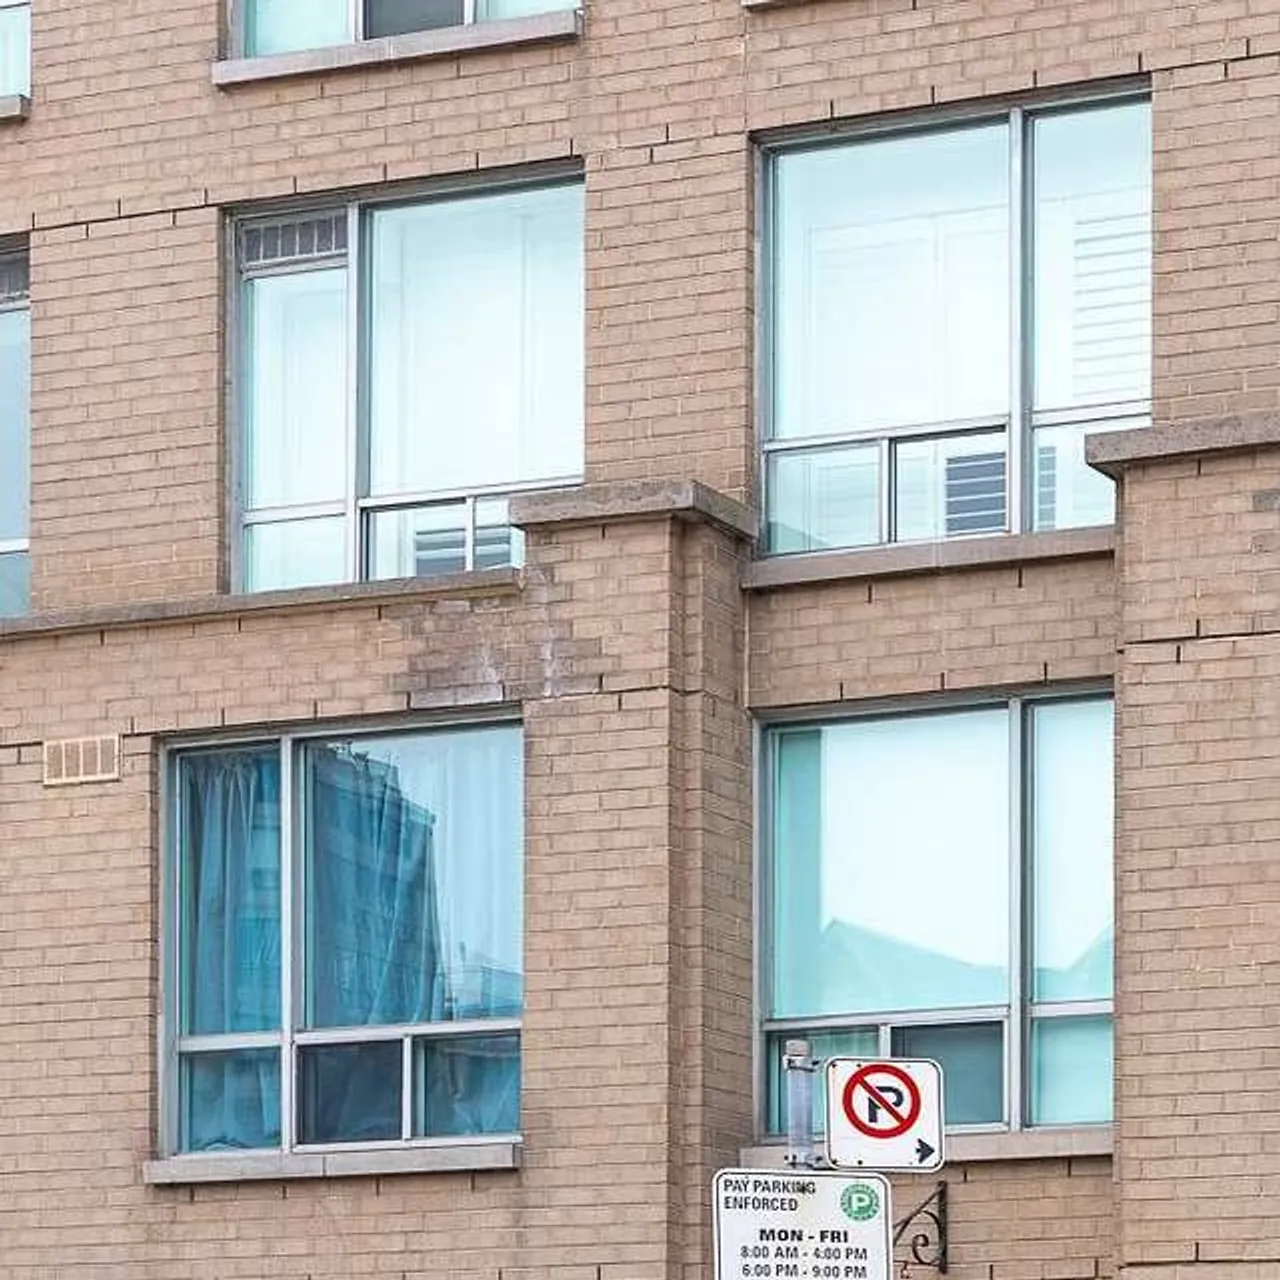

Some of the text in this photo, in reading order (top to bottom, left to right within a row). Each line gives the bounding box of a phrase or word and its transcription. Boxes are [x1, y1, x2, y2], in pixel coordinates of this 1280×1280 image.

[723, 1179, 816, 1194] PAY PARKING
[723, 1197, 798, 1211] ENFORCED
[759, 1229, 803, 1241] MON
[820, 1231, 848, 1243] FRI
[774, 1247, 799, 1259] AM
[845, 1248, 868, 1260] PM
[776, 1264, 799, 1276] PM
[844, 1266, 868, 1278] PM
